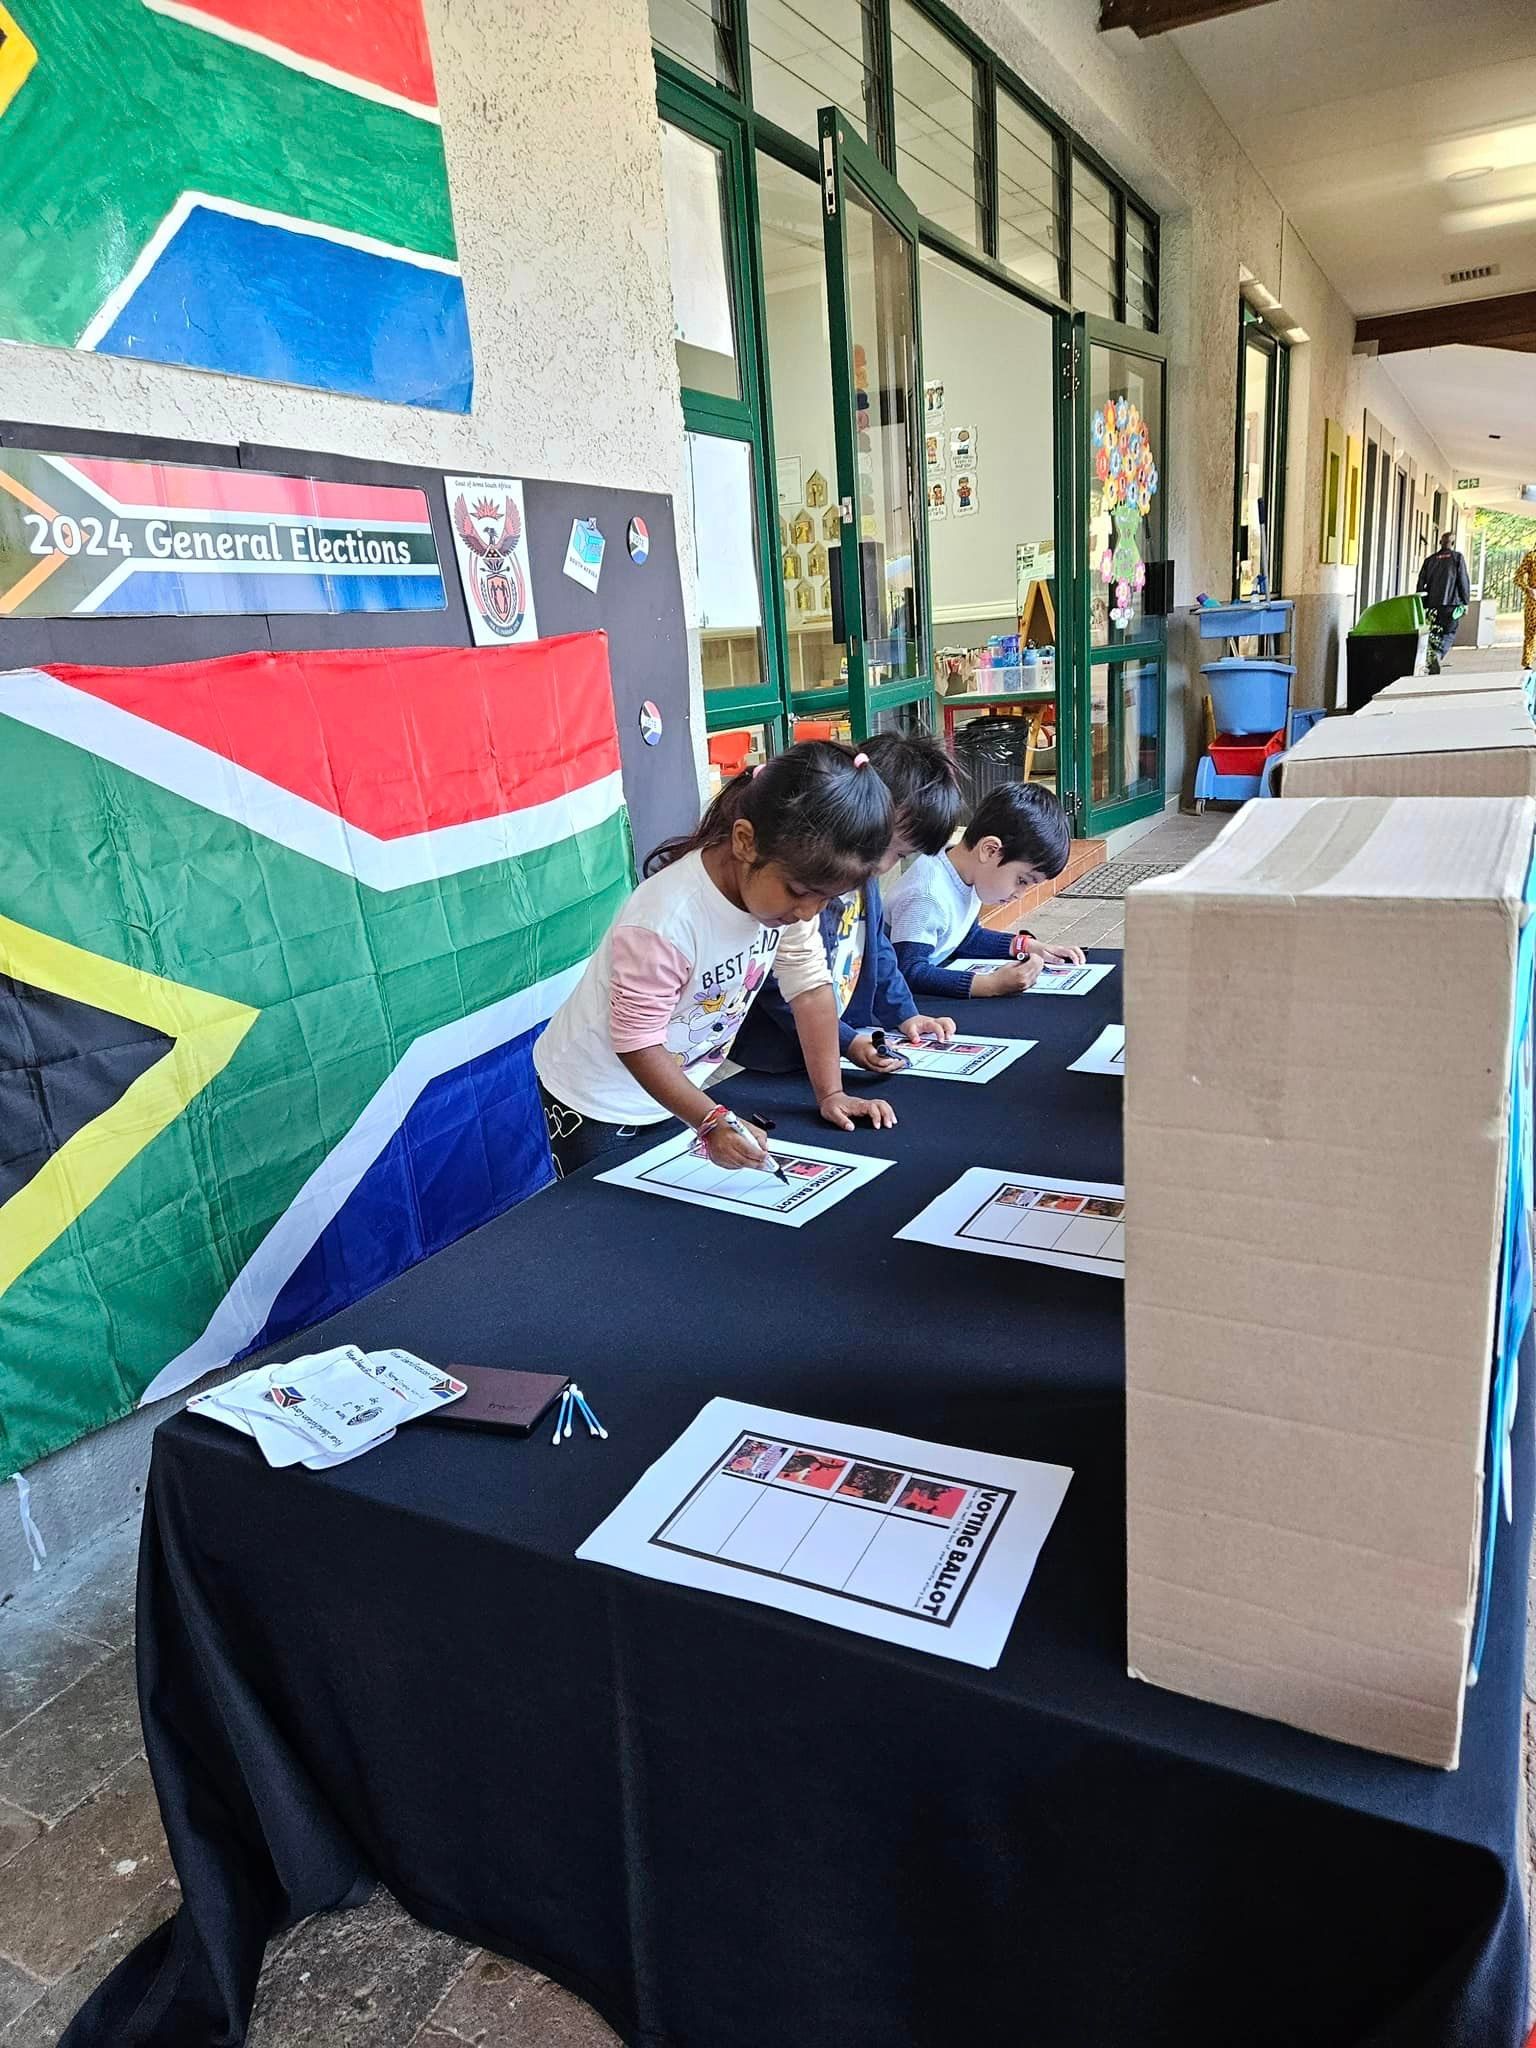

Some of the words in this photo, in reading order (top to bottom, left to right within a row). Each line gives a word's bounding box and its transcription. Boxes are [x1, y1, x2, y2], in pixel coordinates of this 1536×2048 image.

[24, 514, 133, 557] 2024
[145, 520, 283, 561] General
[290, 526, 411, 565] Elections
[702, 952, 744, 990] BEST
[775, 1186, 814, 1210] BALLOT
[808, 1165, 846, 1188] VOTING
[956, 1491, 998, 1548] VOTING
[922, 1550, 968, 1616] BALLOT
